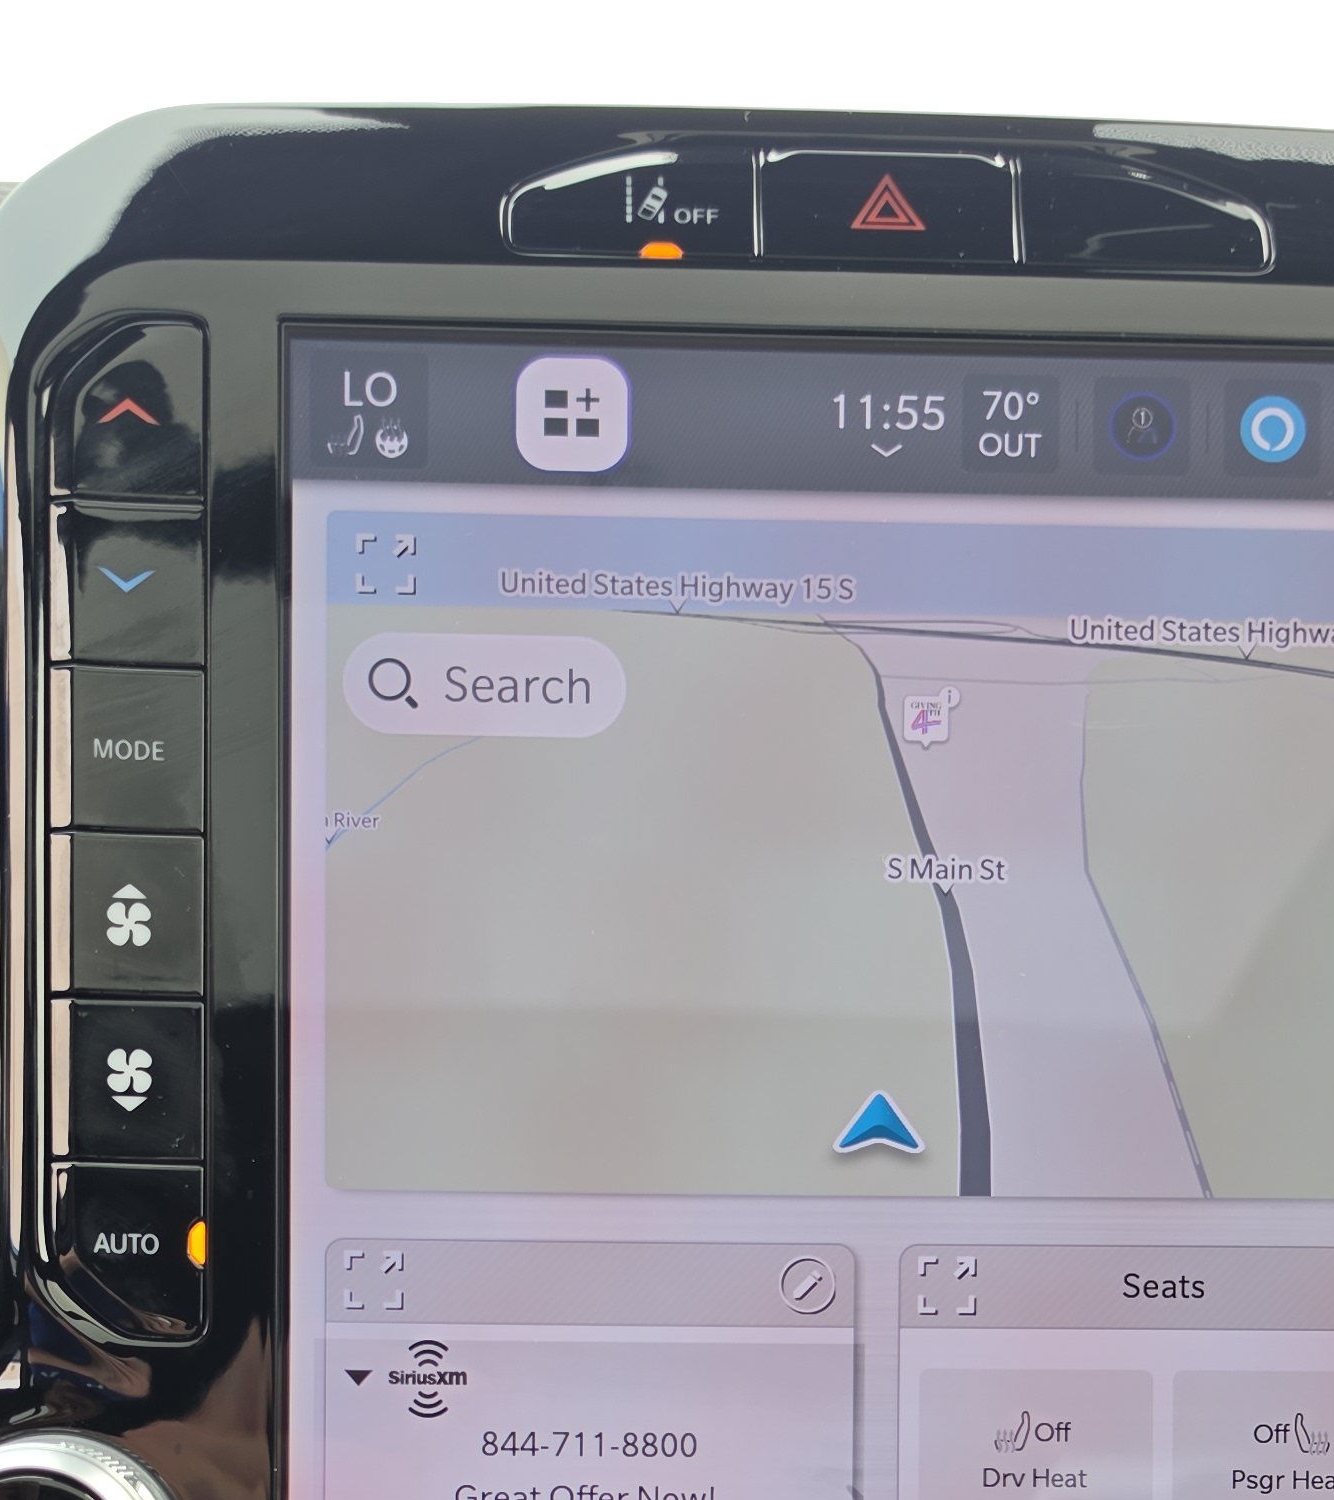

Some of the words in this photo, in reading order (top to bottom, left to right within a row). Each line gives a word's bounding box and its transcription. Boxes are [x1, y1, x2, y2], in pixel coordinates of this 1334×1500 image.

[674, 208, 719, 225] OFF
[343, 371, 398, 408] LO
[832, 393, 945, 431] 11:55
[982, 390, 1041, 421] 70°
[978, 432, 1043, 458] OUT
[501, 572, 586, 594] United
[593, 573, 673, 597] States
[680, 575, 793, 604] Highway
[802, 578, 832, 600] 15
[839, 578, 854, 600] S
[1070, 618, 1154, 641] United
[1162, 620, 1240, 643] States
[444, 666, 591, 705] Search
[93, 738, 165, 761] MODE
[335, 812, 379, 828] River
[888, 858, 902, 879] S
[910, 858, 972, 880] Main
[980, 859, 1005, 880] St
[93, 1232, 160, 1255] AUTO
[1122, 1272, 1205, 1299] Seats
[481, 1430, 698, 1458] 844-711-8800
[1034, 1421, 1072, 1443] Off
[1253, 1423, 1291, 1444] Off
[982, 1467, 1026, 1488] Drv
[1032, 1468, 1088, 1488] Heat
[1232, 1469, 1286, 1495] Psgr
